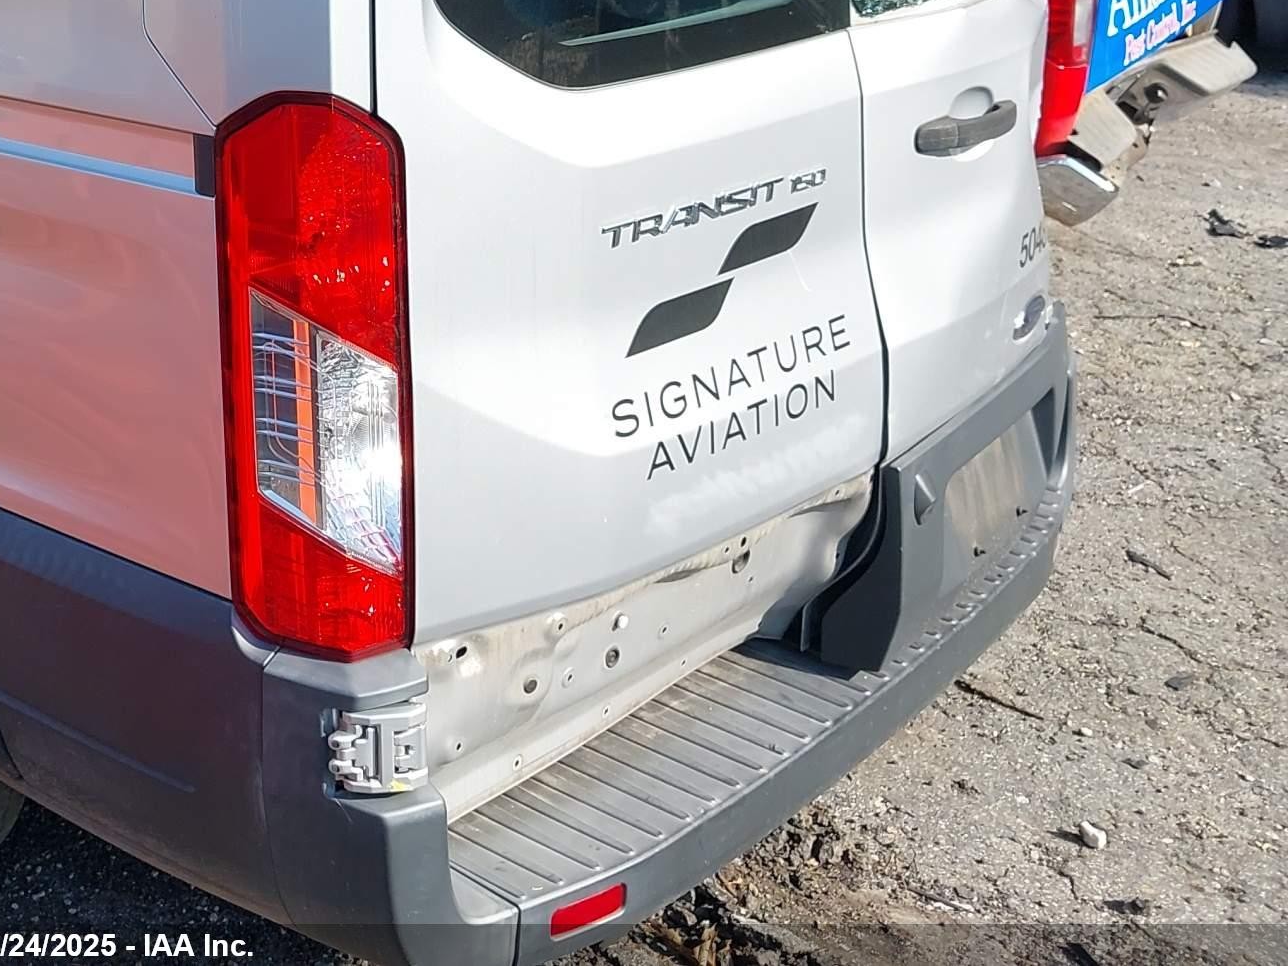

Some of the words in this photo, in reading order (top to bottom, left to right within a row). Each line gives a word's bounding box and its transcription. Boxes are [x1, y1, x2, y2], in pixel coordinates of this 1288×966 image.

[601, 177, 785, 248] TRANSIT
[789, 169, 827, 195] 150
[1019, 224, 1046, 268] 504
[612, 314, 851, 437] SIGNATURE
[646, 370, 835, 481] AVIATION
